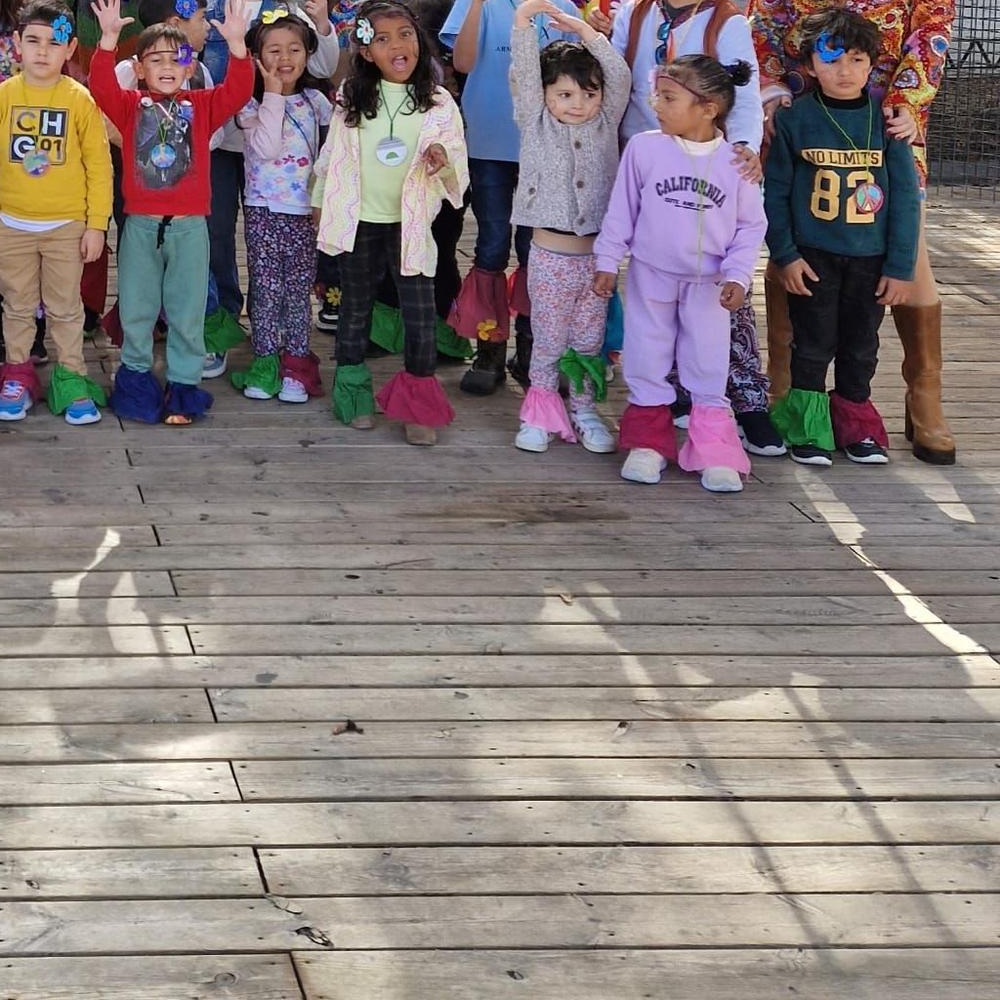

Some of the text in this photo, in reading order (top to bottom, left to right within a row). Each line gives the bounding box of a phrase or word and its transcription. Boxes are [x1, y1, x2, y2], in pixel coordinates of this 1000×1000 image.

[805, 150, 879, 165] NO LIMITS
[655, 175, 727, 208] CALIFORNIA
[811, 168, 875, 224] 82
